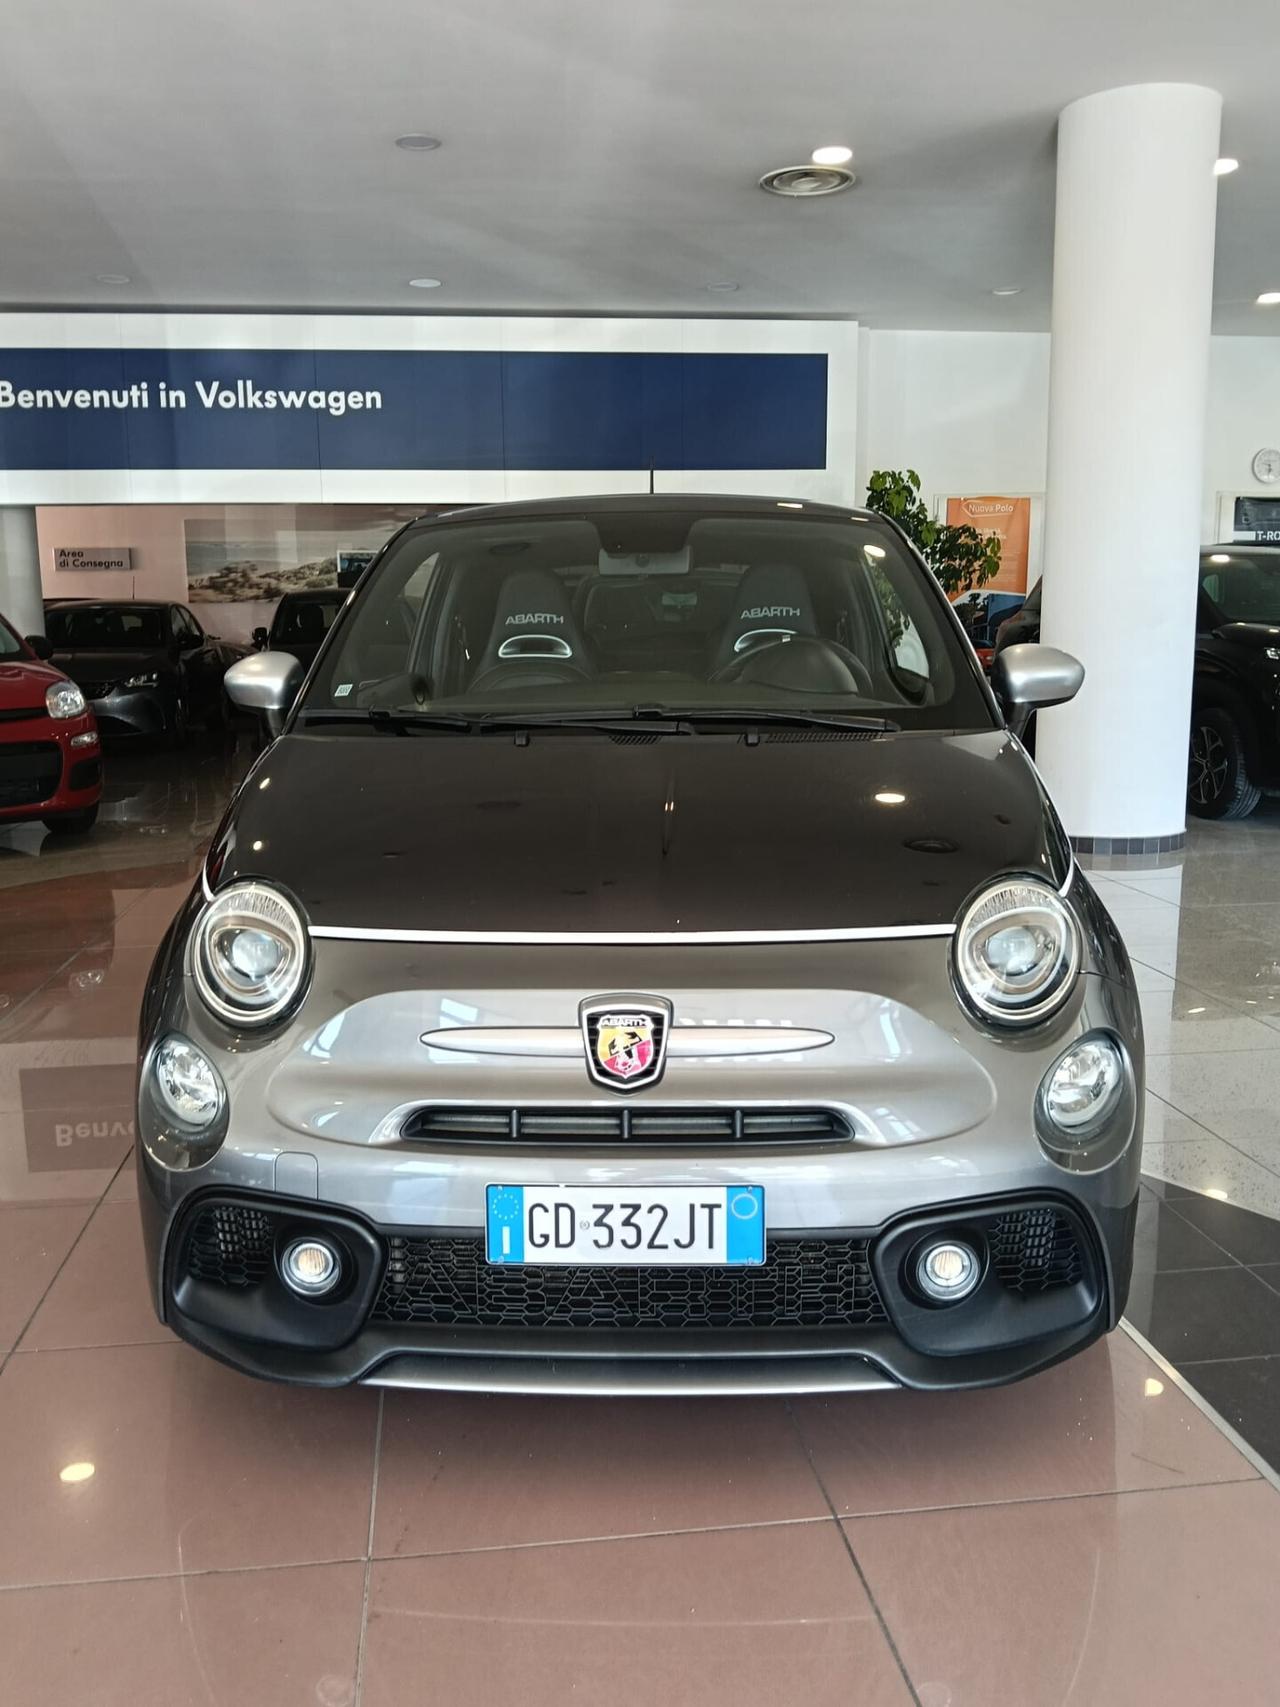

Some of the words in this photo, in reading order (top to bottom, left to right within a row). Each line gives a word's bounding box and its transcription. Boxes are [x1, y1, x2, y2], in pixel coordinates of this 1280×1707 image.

[0, 380, 149, 409] Benvenuti
[159, 382, 186, 409] in
[195, 380, 382, 416] Volkswagen
[995, 503, 1014, 513] Polo
[59, 549, 84, 558] Area
[59, 559, 69, 568] di
[72, 559, 124, 569] Consegna
[740, 606, 801, 619] ABARTH
[505, 613, 564, 626] ABARTH
[528, 1202, 576, 1249] GD
[592, 1202, 722, 1250] 332JT
